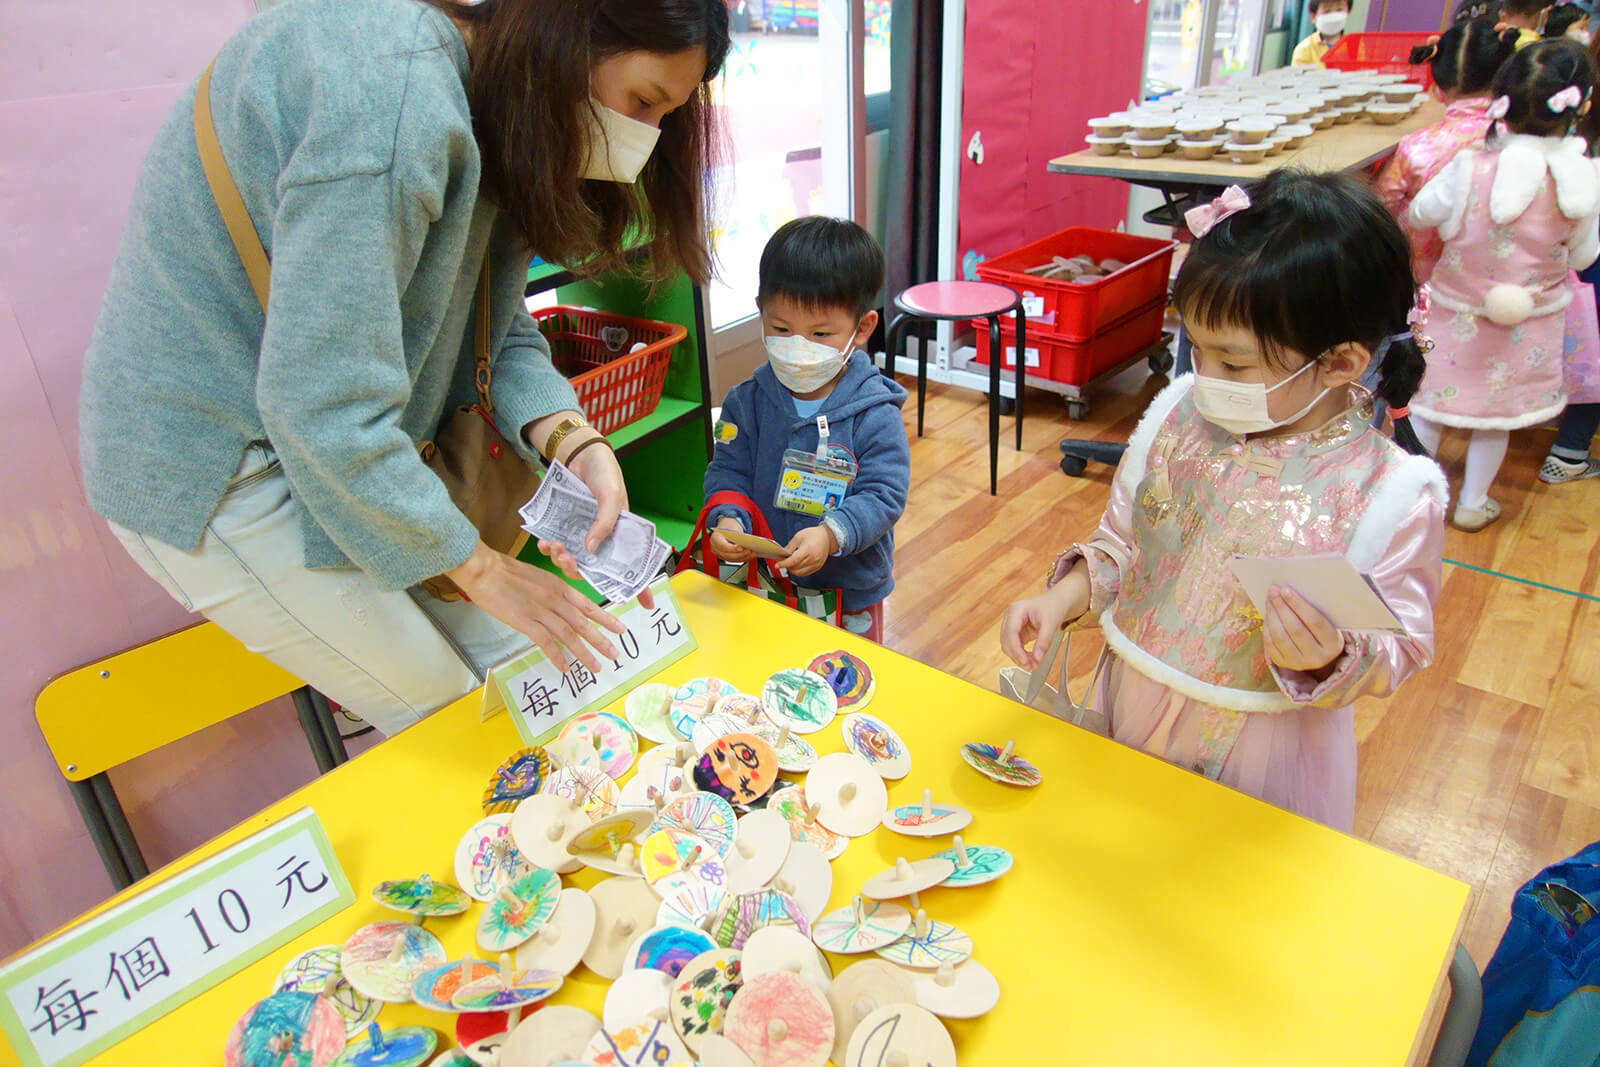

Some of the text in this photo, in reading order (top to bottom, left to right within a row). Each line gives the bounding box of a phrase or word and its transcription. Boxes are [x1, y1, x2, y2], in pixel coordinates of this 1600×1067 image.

[521, 657, 598, 718] 每個
[650, 607, 682, 646] 元
[29, 855, 329, 1036] 每個 10 元
